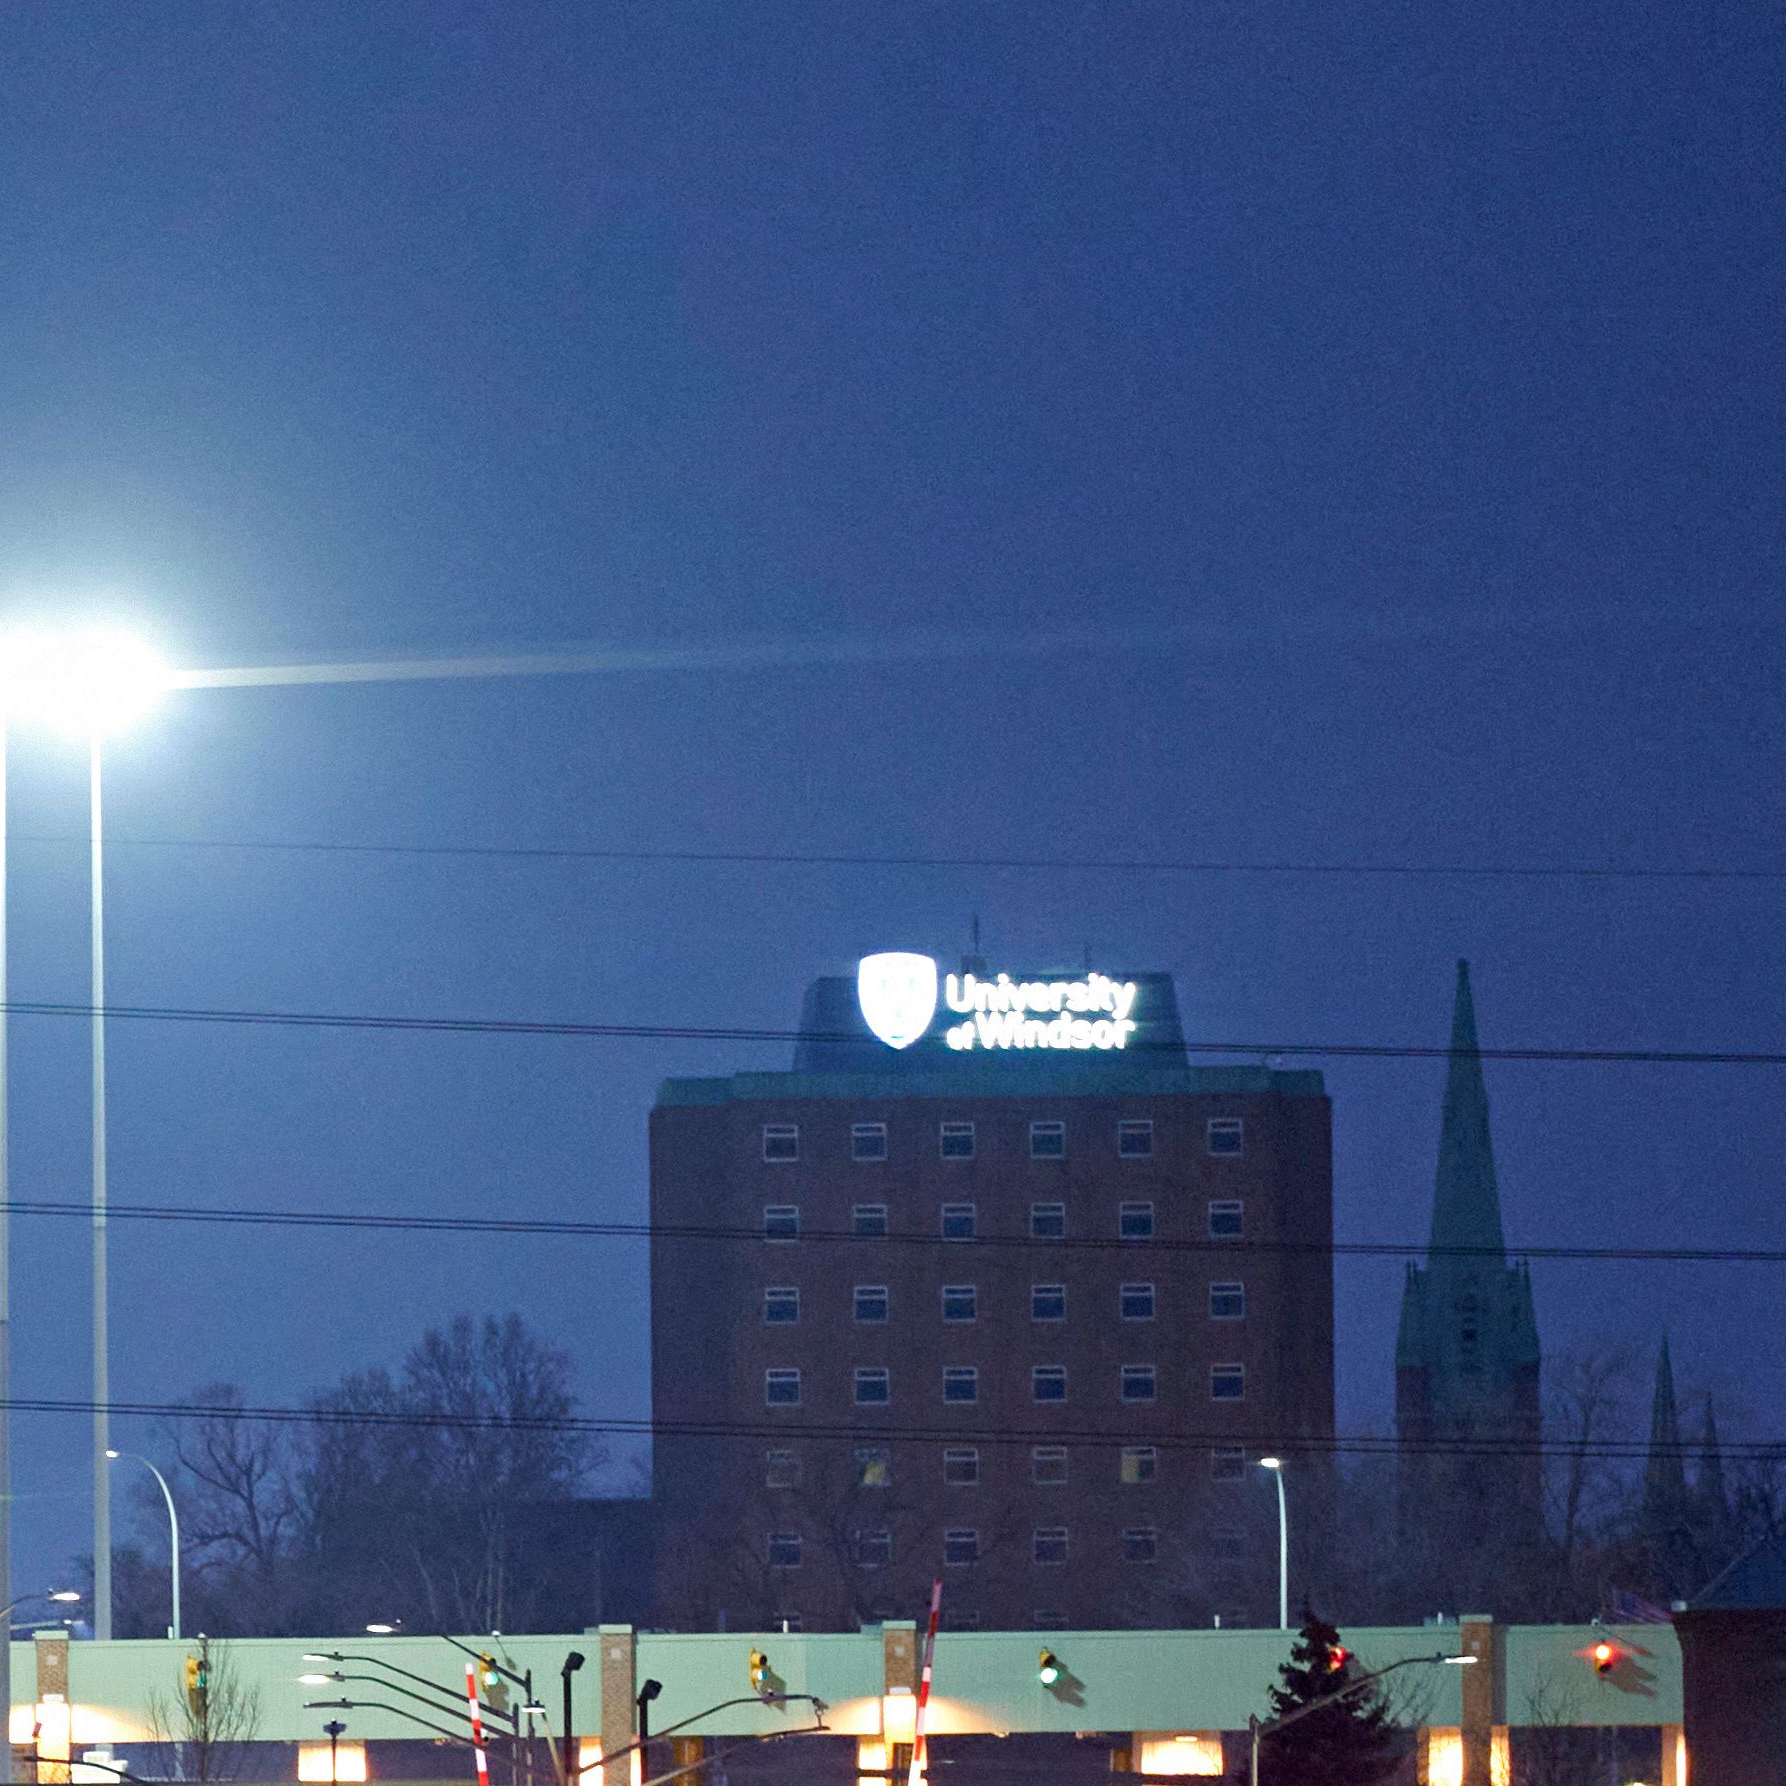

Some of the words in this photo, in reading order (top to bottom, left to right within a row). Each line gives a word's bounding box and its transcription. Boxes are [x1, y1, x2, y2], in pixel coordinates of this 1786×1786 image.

[946, 973, 1136, 1020] University
[945, 1020, 975, 1050] of
[974, 1011, 1136, 1049] Windsor
